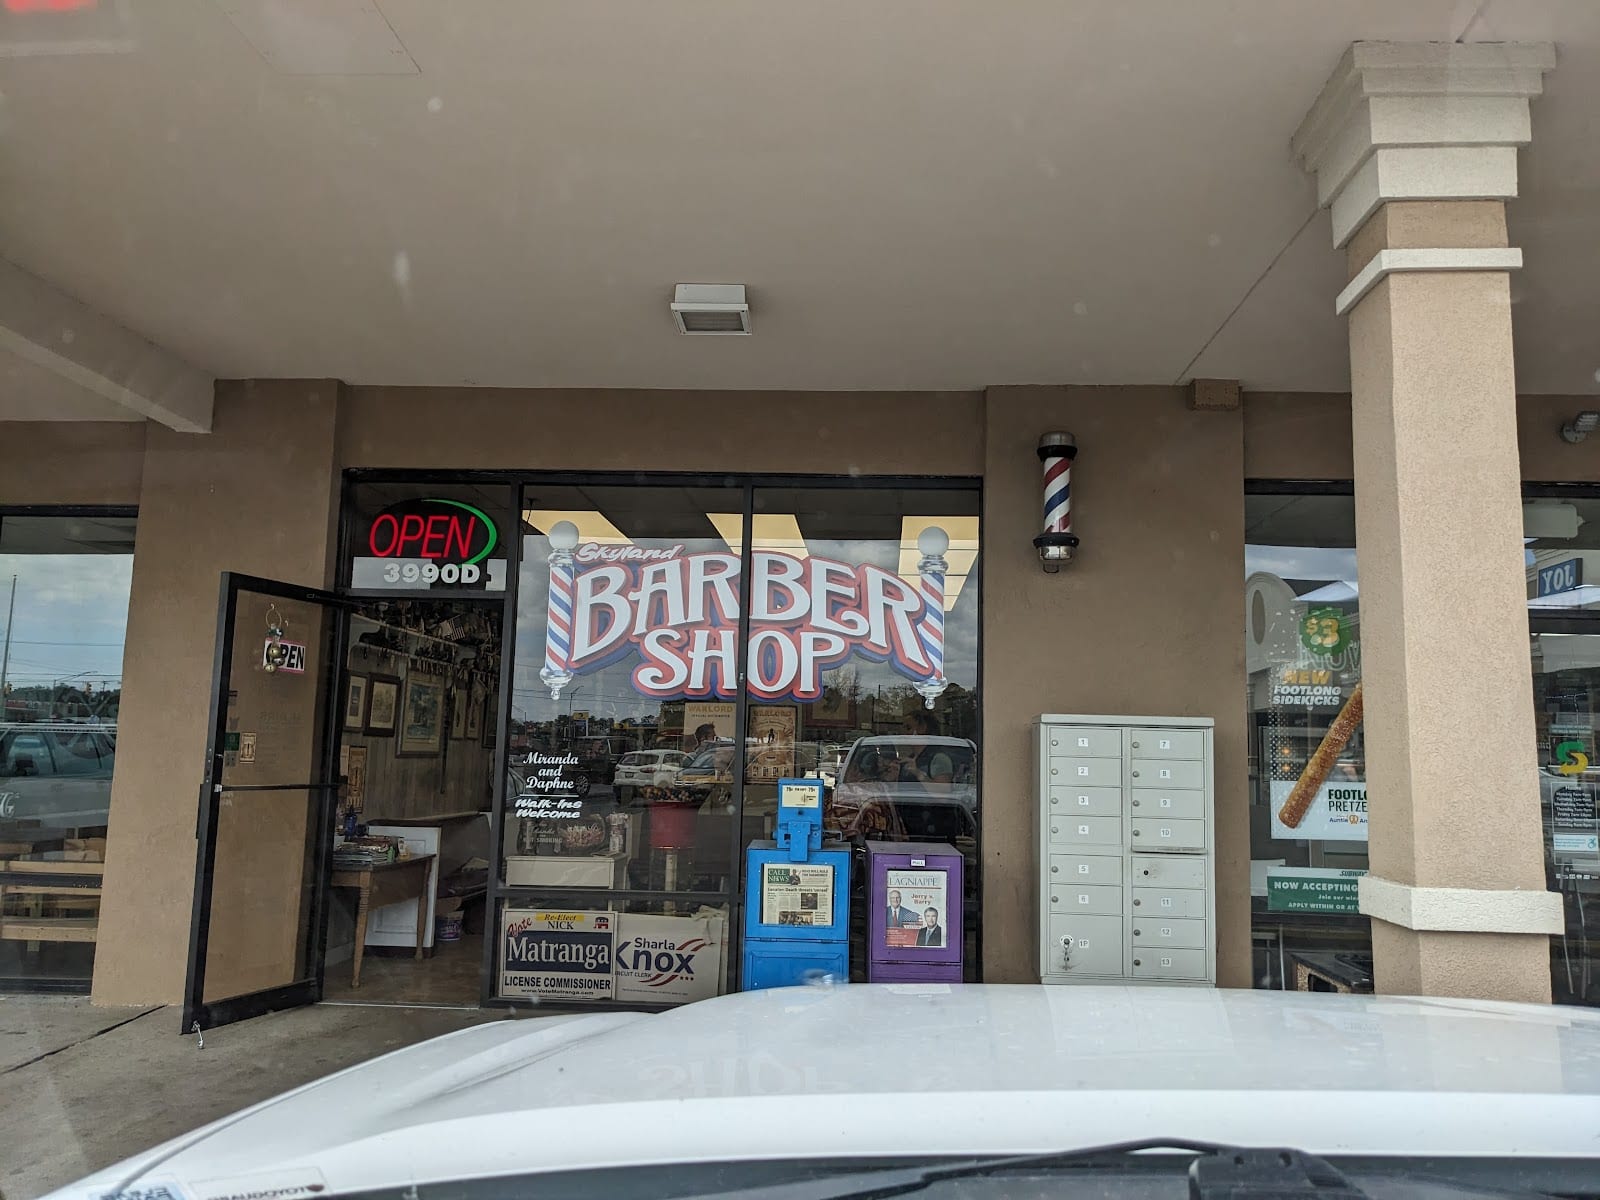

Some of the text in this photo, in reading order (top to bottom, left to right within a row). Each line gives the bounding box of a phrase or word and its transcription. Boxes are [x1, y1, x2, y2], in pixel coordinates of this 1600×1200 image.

[369, 513, 477, 558] OPEN
[576, 542, 684, 562] Skyland
[383, 562, 481, 584] 3990D
[570, 551, 931, 672] BARBER
[635, 628, 847, 692] SHOP
[1273, 685, 1342, 695] FOOTLONG
[1272, 695, 1340, 705] SIDEKICKS
[523, 752, 579, 765] Miranda
[538, 765, 563, 777] and
[526, 776, 575, 792] Daphne
[1328, 788, 1368, 800] FOOTL
[515, 798, 583, 809] Walk-Ins
[1328, 800, 1368, 812] PRETZE
[516, 808, 581, 819] Welcome
[889, 877, 938, 886] LAGNIAPPE
[1274, 881, 1359, 891] NOW ACCEPTING
[544, 913, 577, 922] Re-Elect
[507, 917, 533, 937] Vote
[547, 921, 574, 930] NICK
[634, 937, 676, 950] Sharla
[507, 936, 610, 970] Matranga
[615, 941, 695, 975] Knox
[504, 975, 611, 990] LICENSE COMMISSIONER
[521, 988, 594, 996] www.VoteMatranga.com
